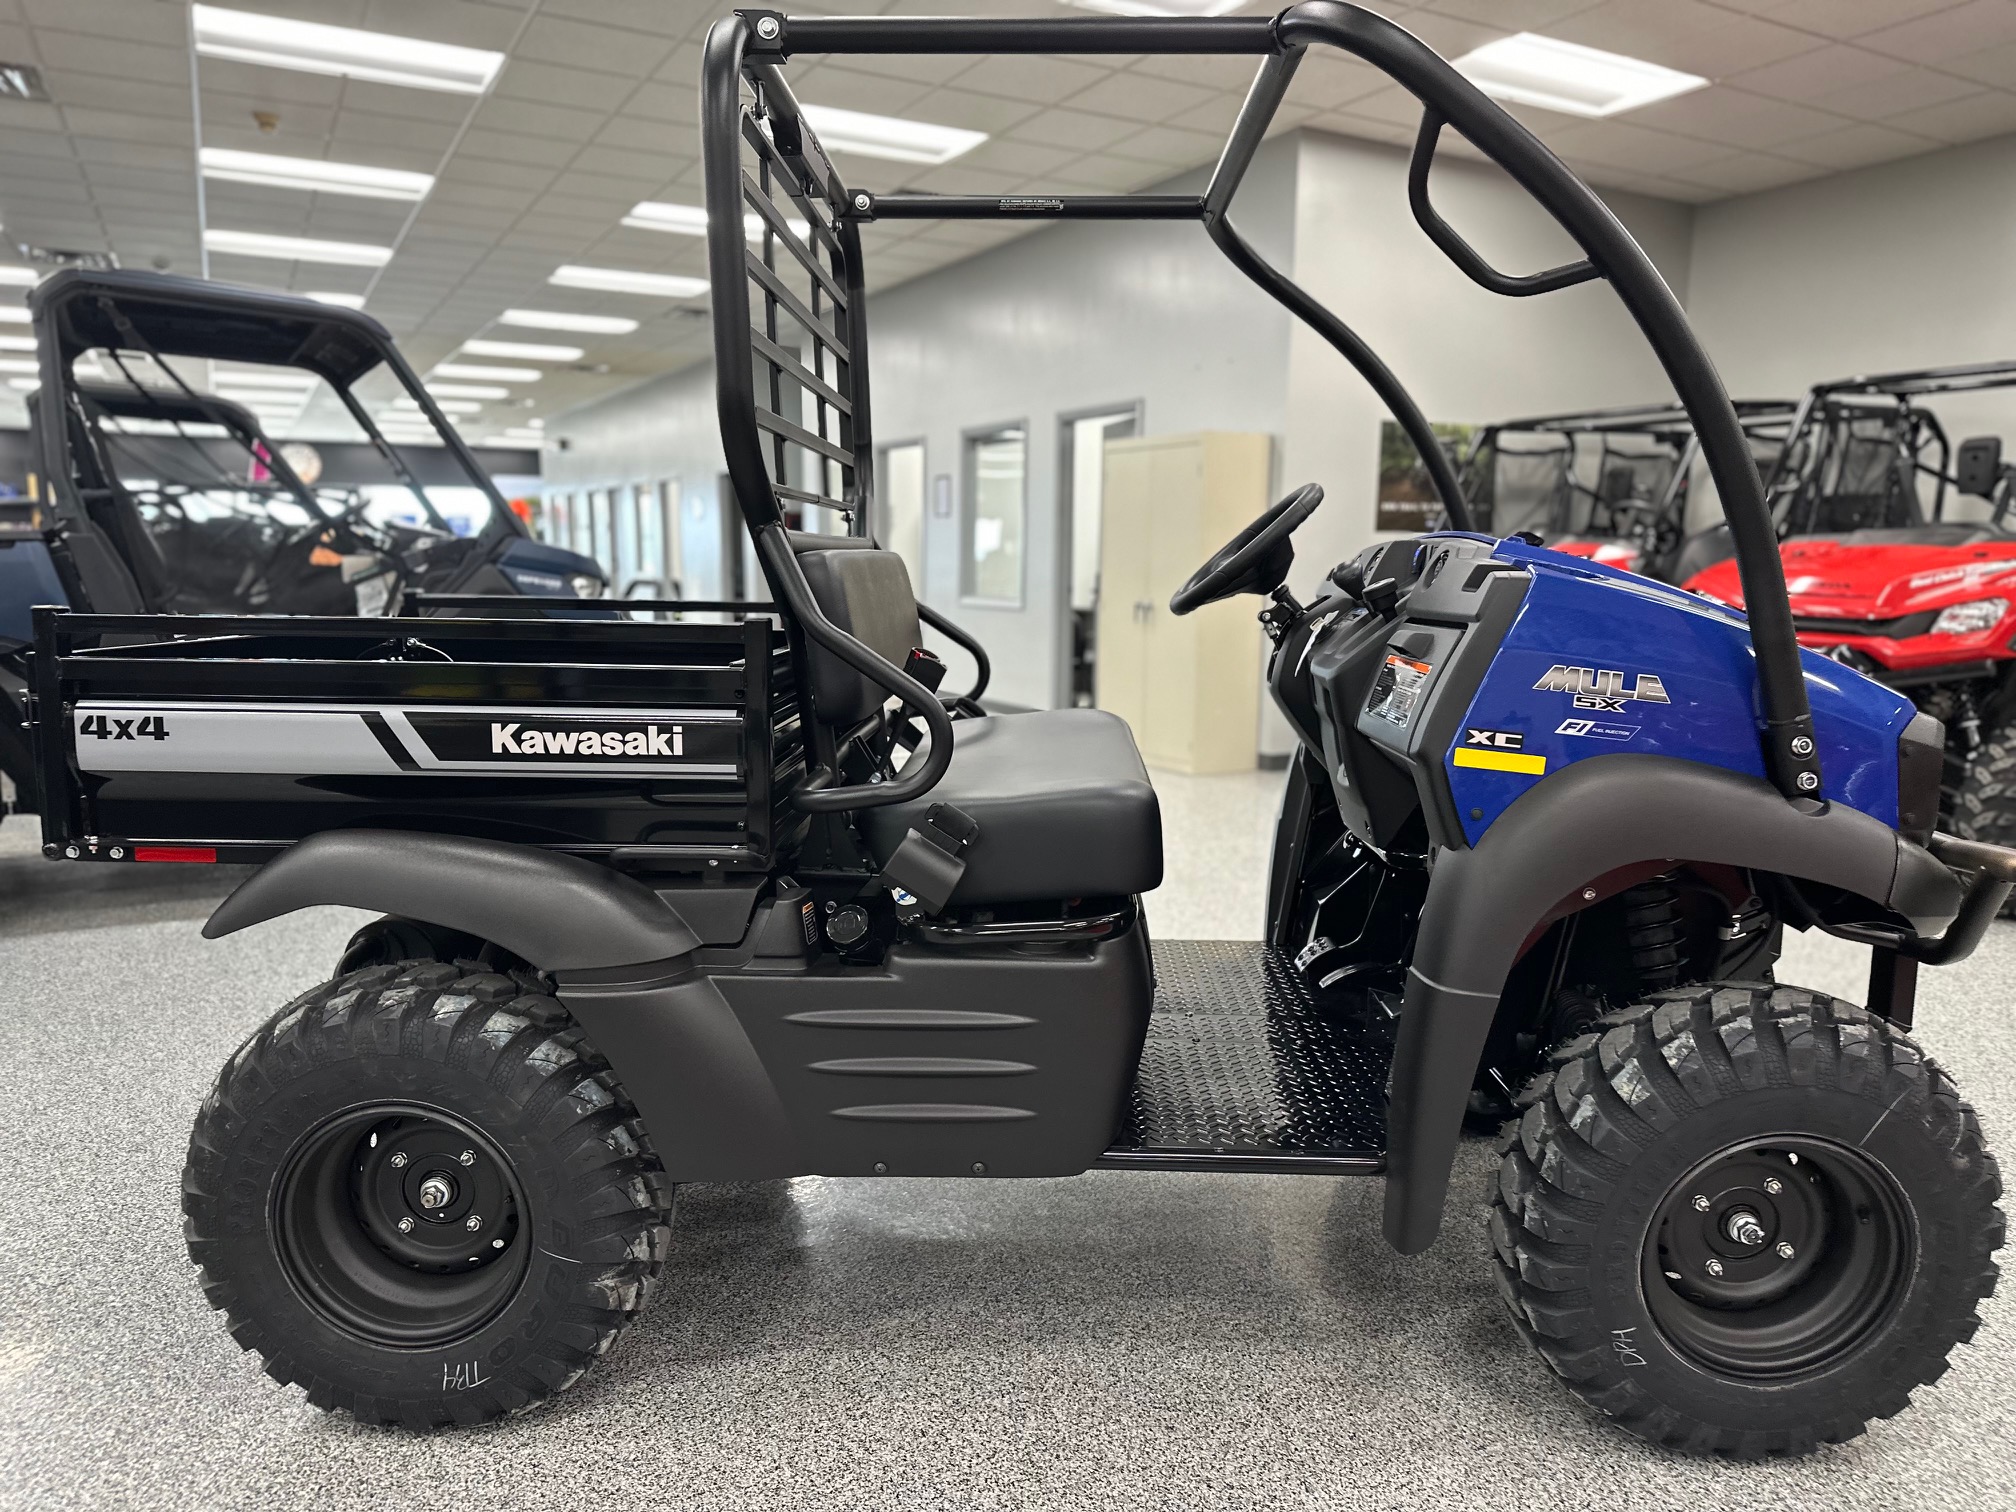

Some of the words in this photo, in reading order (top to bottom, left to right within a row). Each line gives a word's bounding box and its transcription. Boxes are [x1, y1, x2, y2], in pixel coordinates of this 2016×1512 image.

[1532, 665, 1671, 704] MULE
[1573, 695, 1627, 713] SX
[80, 715, 170, 741] 4x4
[491, 723, 683, 756] Kawasaki
[1466, 729, 1523, 749] XC
